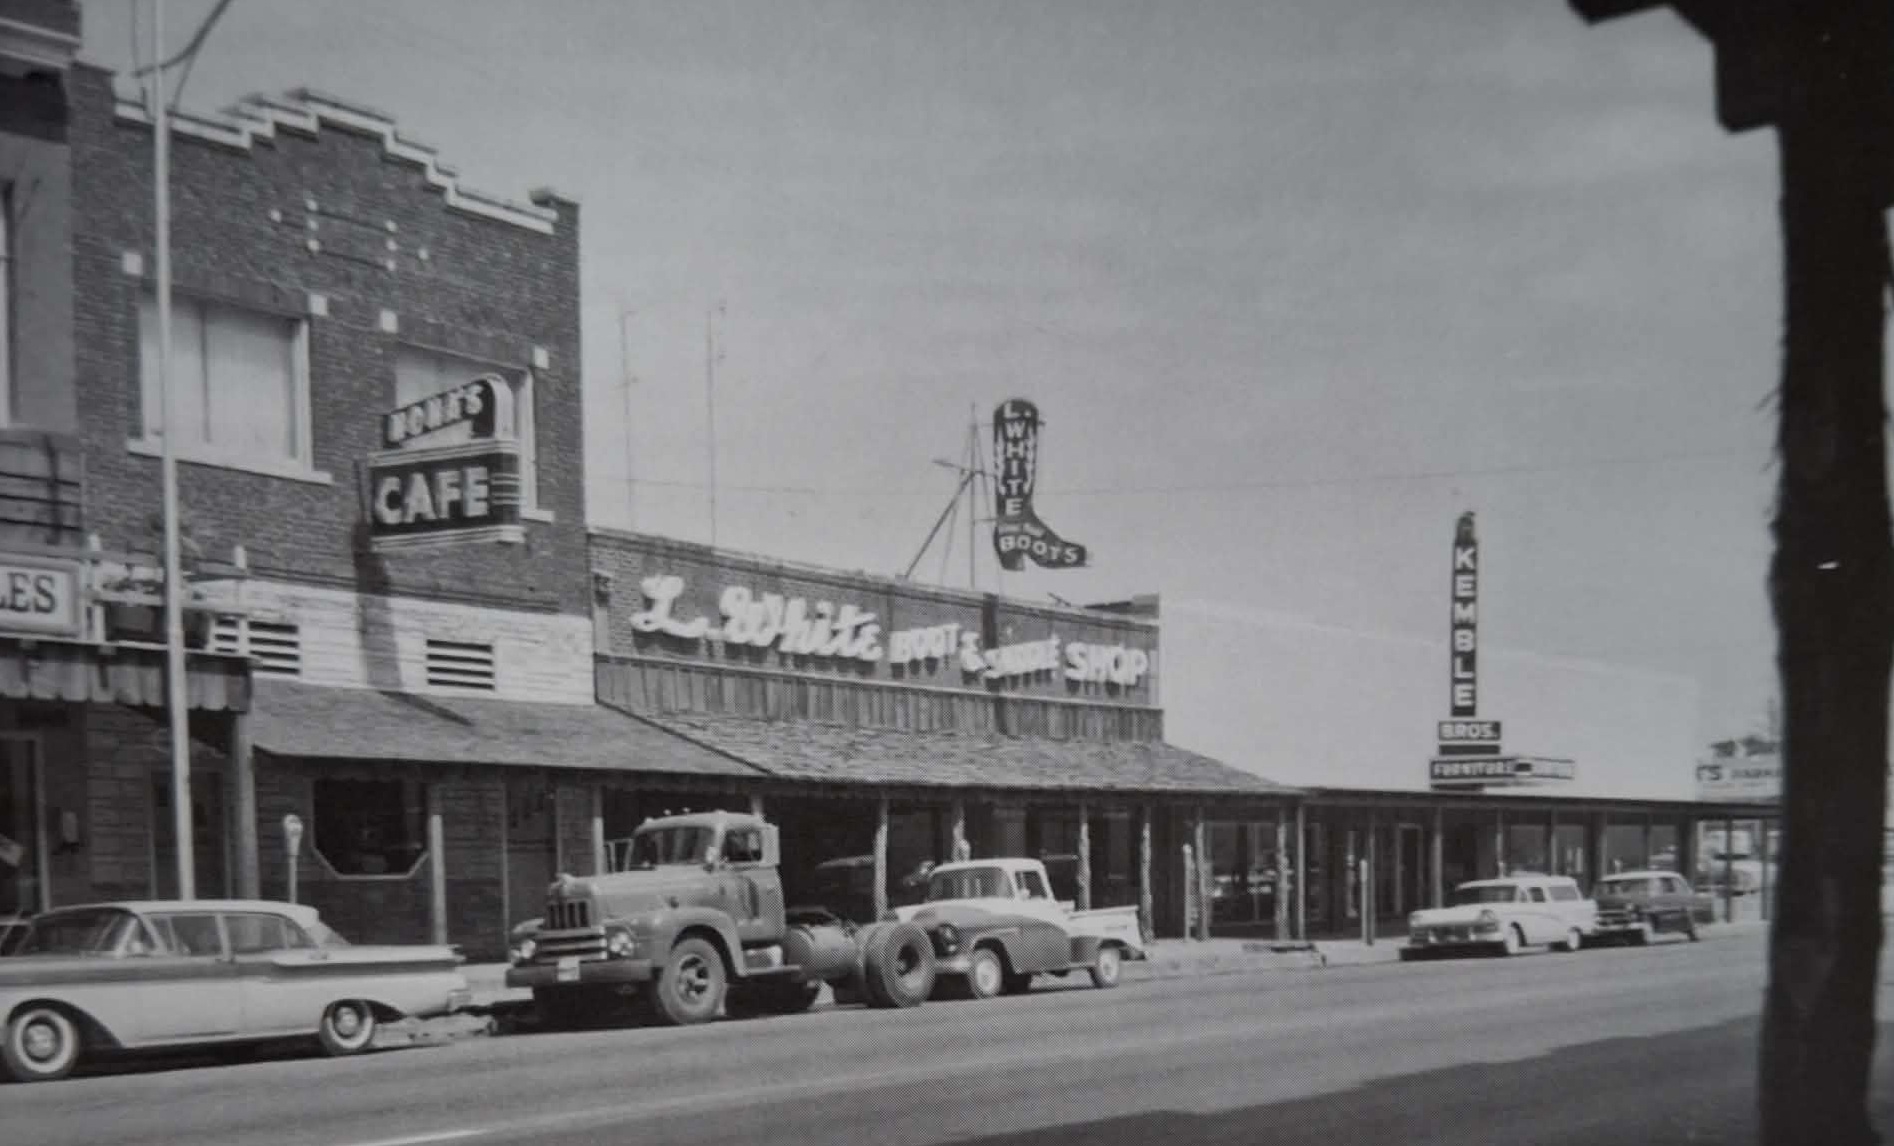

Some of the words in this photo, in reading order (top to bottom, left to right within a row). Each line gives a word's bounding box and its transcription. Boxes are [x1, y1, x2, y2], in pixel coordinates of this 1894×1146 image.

[374, 466, 489, 525] CAFE
[1004, 421, 1025, 516] WHITE
[999, 535, 1080, 564] BOOTS
[719, 586, 883, 662] White
[1064, 642, 1148, 686] SHOP
[1454, 547, 1475, 707] KEMBLE
[1440, 724, 1499, 739] BROS.
